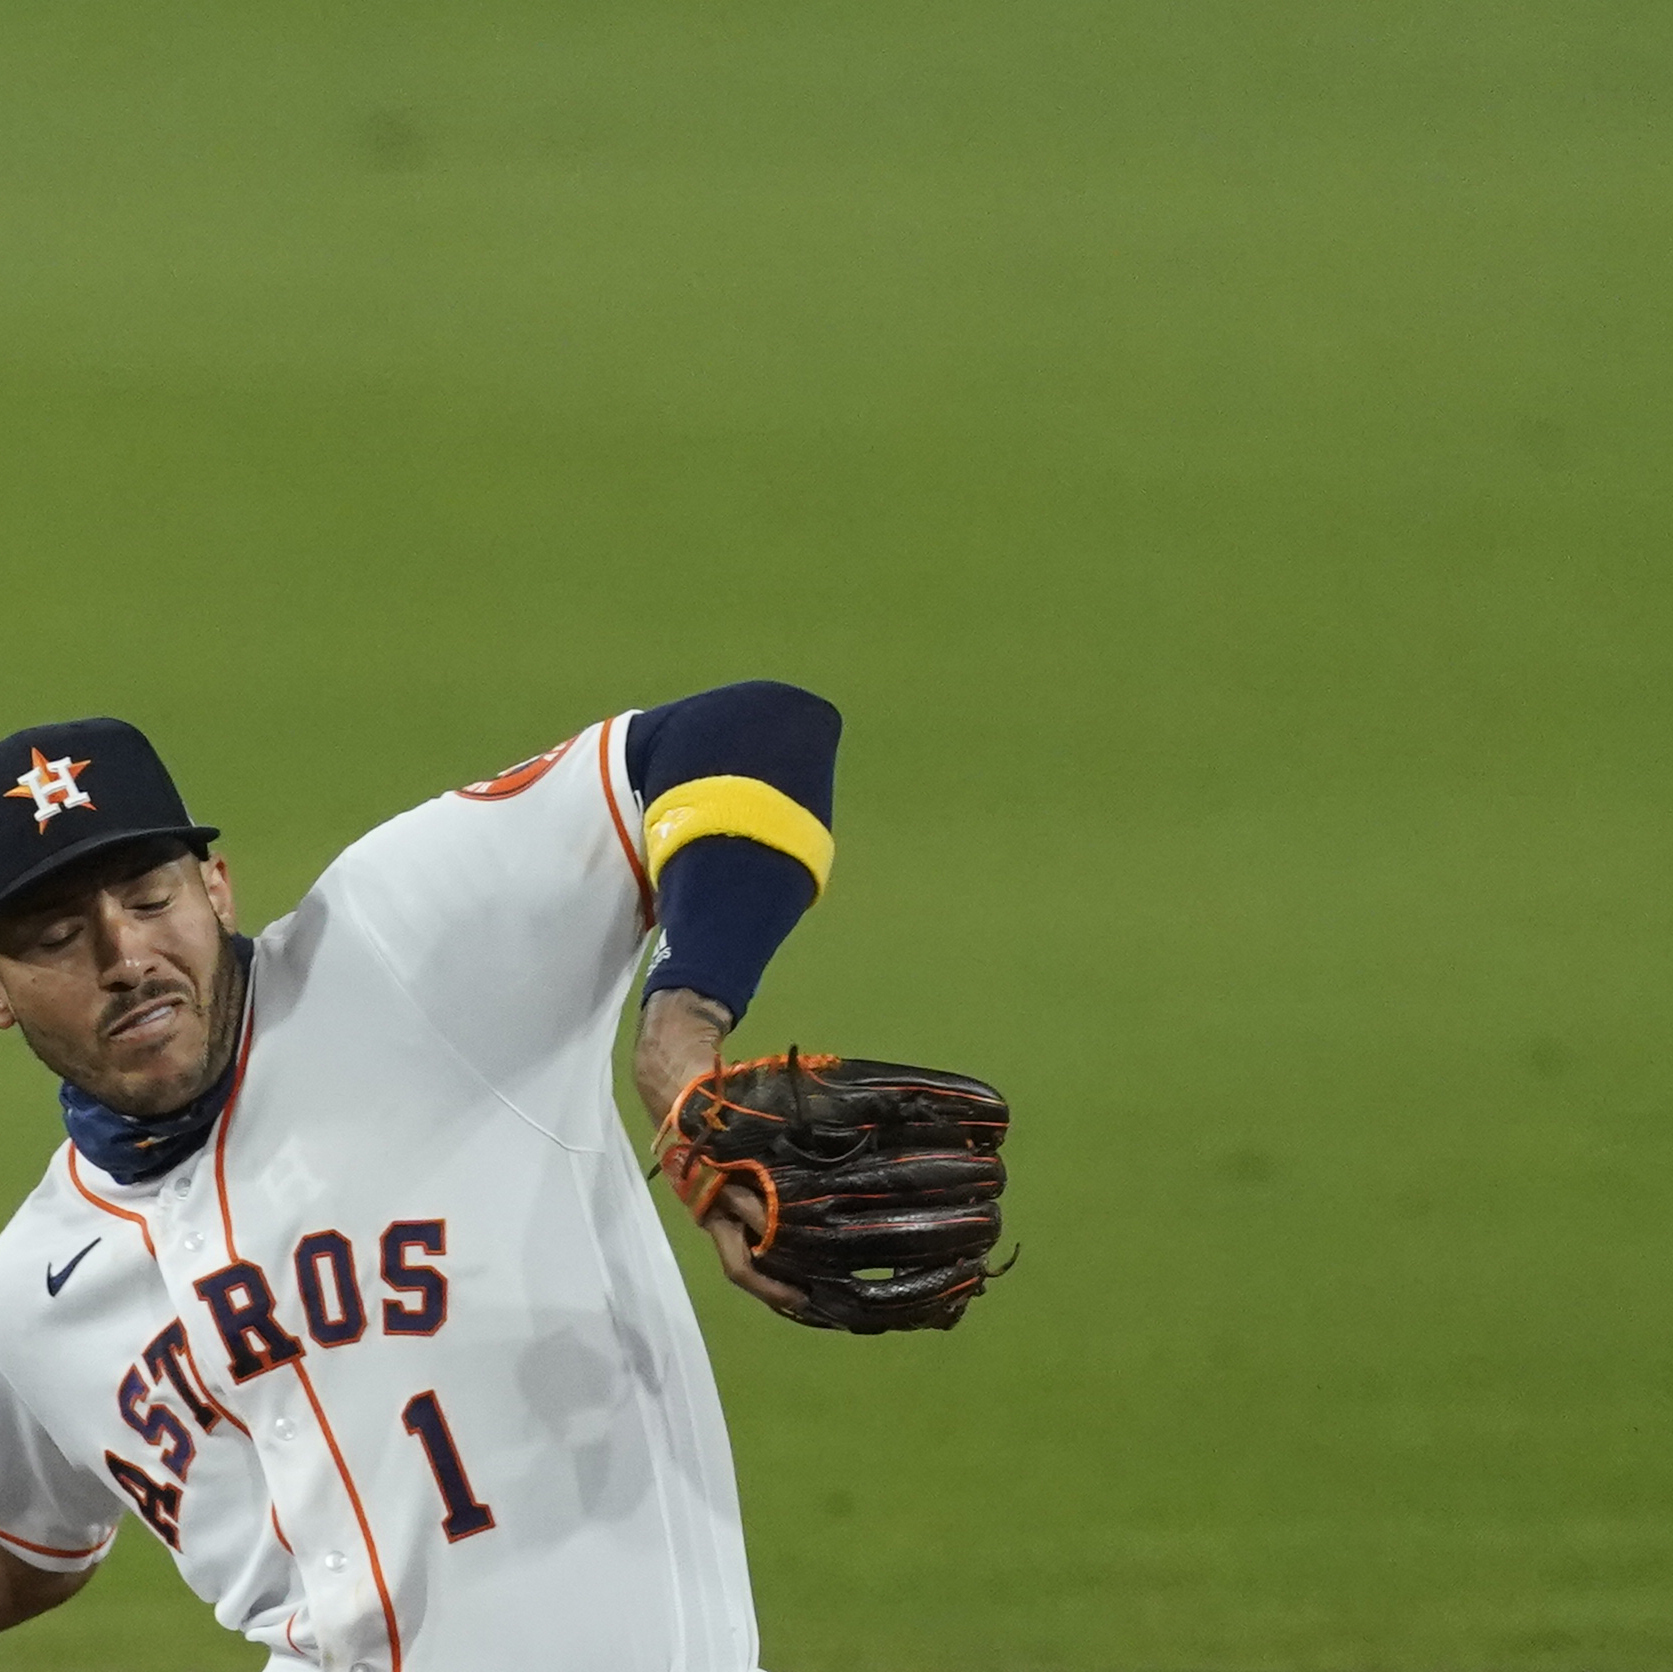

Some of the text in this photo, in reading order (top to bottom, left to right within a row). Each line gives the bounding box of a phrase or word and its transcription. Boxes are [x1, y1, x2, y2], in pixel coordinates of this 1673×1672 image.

[17, 756, 91, 822] H
[104, 1218, 447, 1554] ASTROS
[401, 1389, 496, 1545] 1
